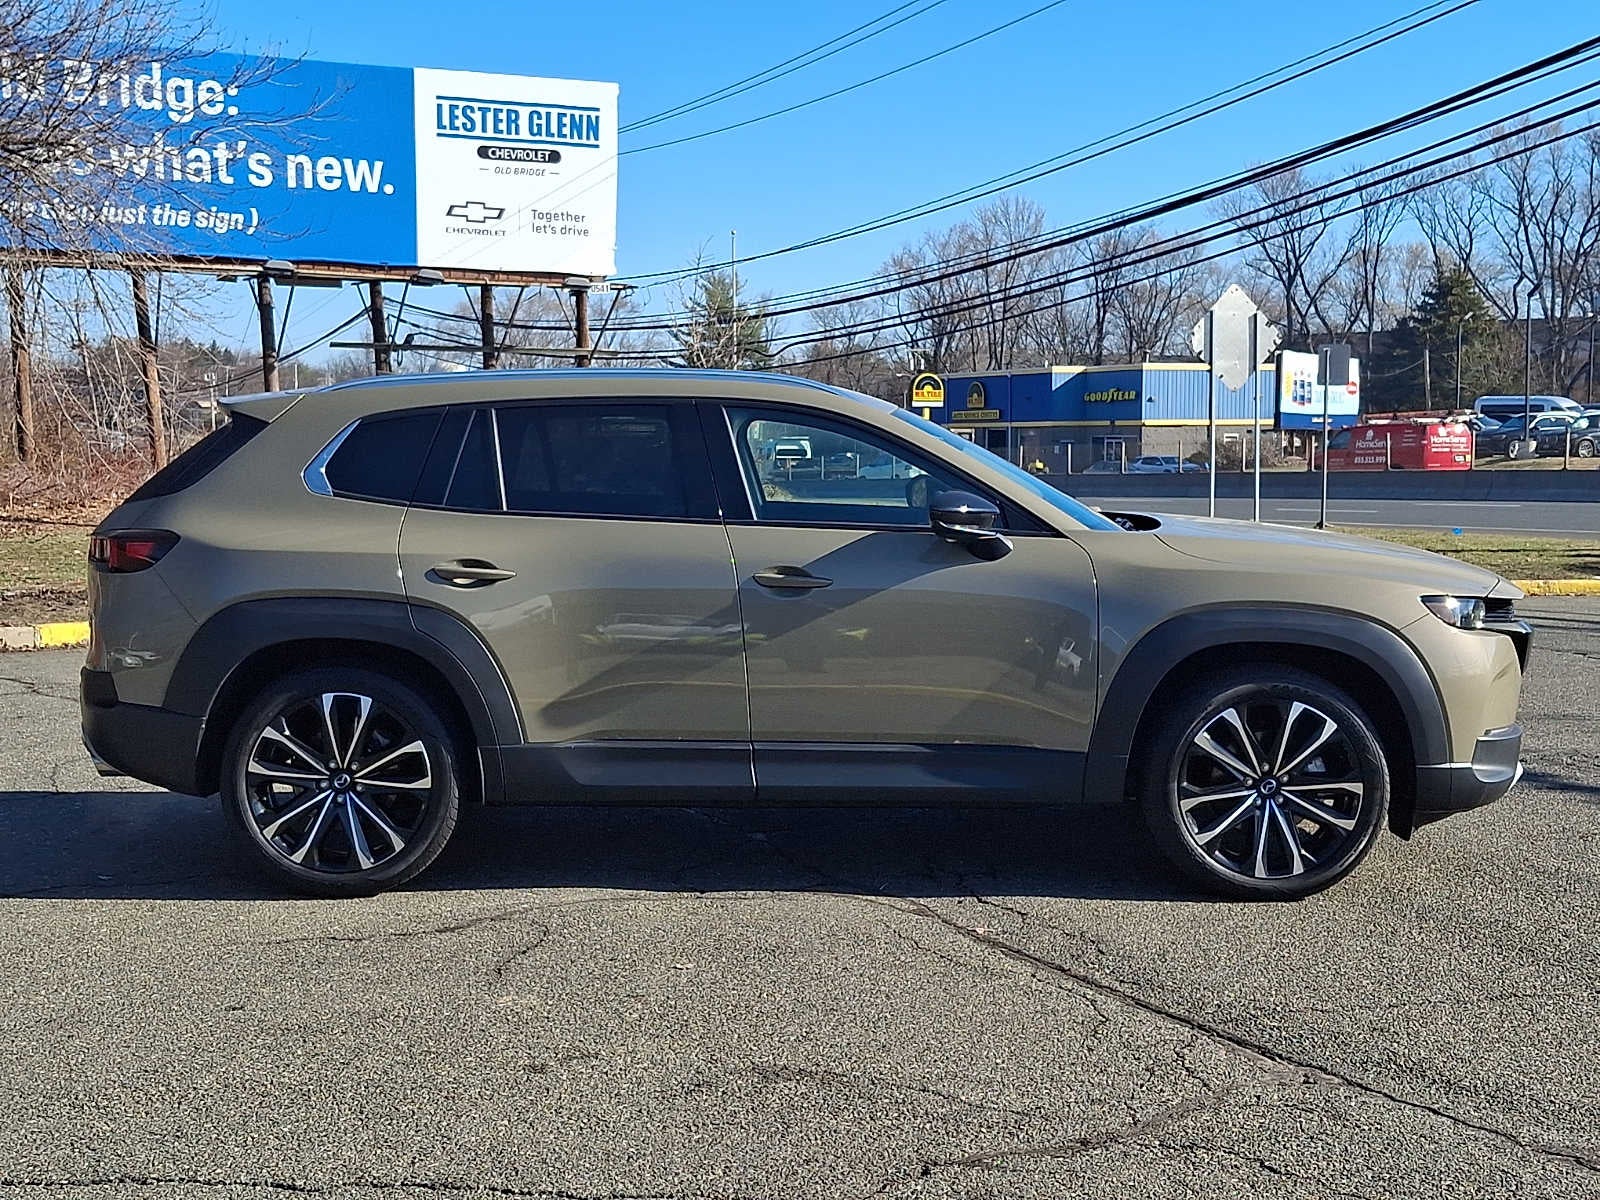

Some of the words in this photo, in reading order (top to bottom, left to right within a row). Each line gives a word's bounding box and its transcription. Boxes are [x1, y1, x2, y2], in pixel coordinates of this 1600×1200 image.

[63, 59, 240, 123] Bridge:
[436, 103, 520, 136] LESTER
[528, 110, 600, 142] GLENN
[487, 146, 551, 162] CHEVROLET
[109, 132, 274, 188] what's
[286, 155, 395, 194] new.
[494, 166, 512, 175] OLD
[514, 167, 546, 177] BRIDGE
[101, 201, 147, 225] just
[152, 203, 191, 227] the
[531, 208, 586, 223] Together
[445, 226, 506, 237] CHEVROLET
[532, 222, 557, 235] let's
[560, 225, 590, 237] drive
[1083, 387, 1137, 404] GOODYEAR
